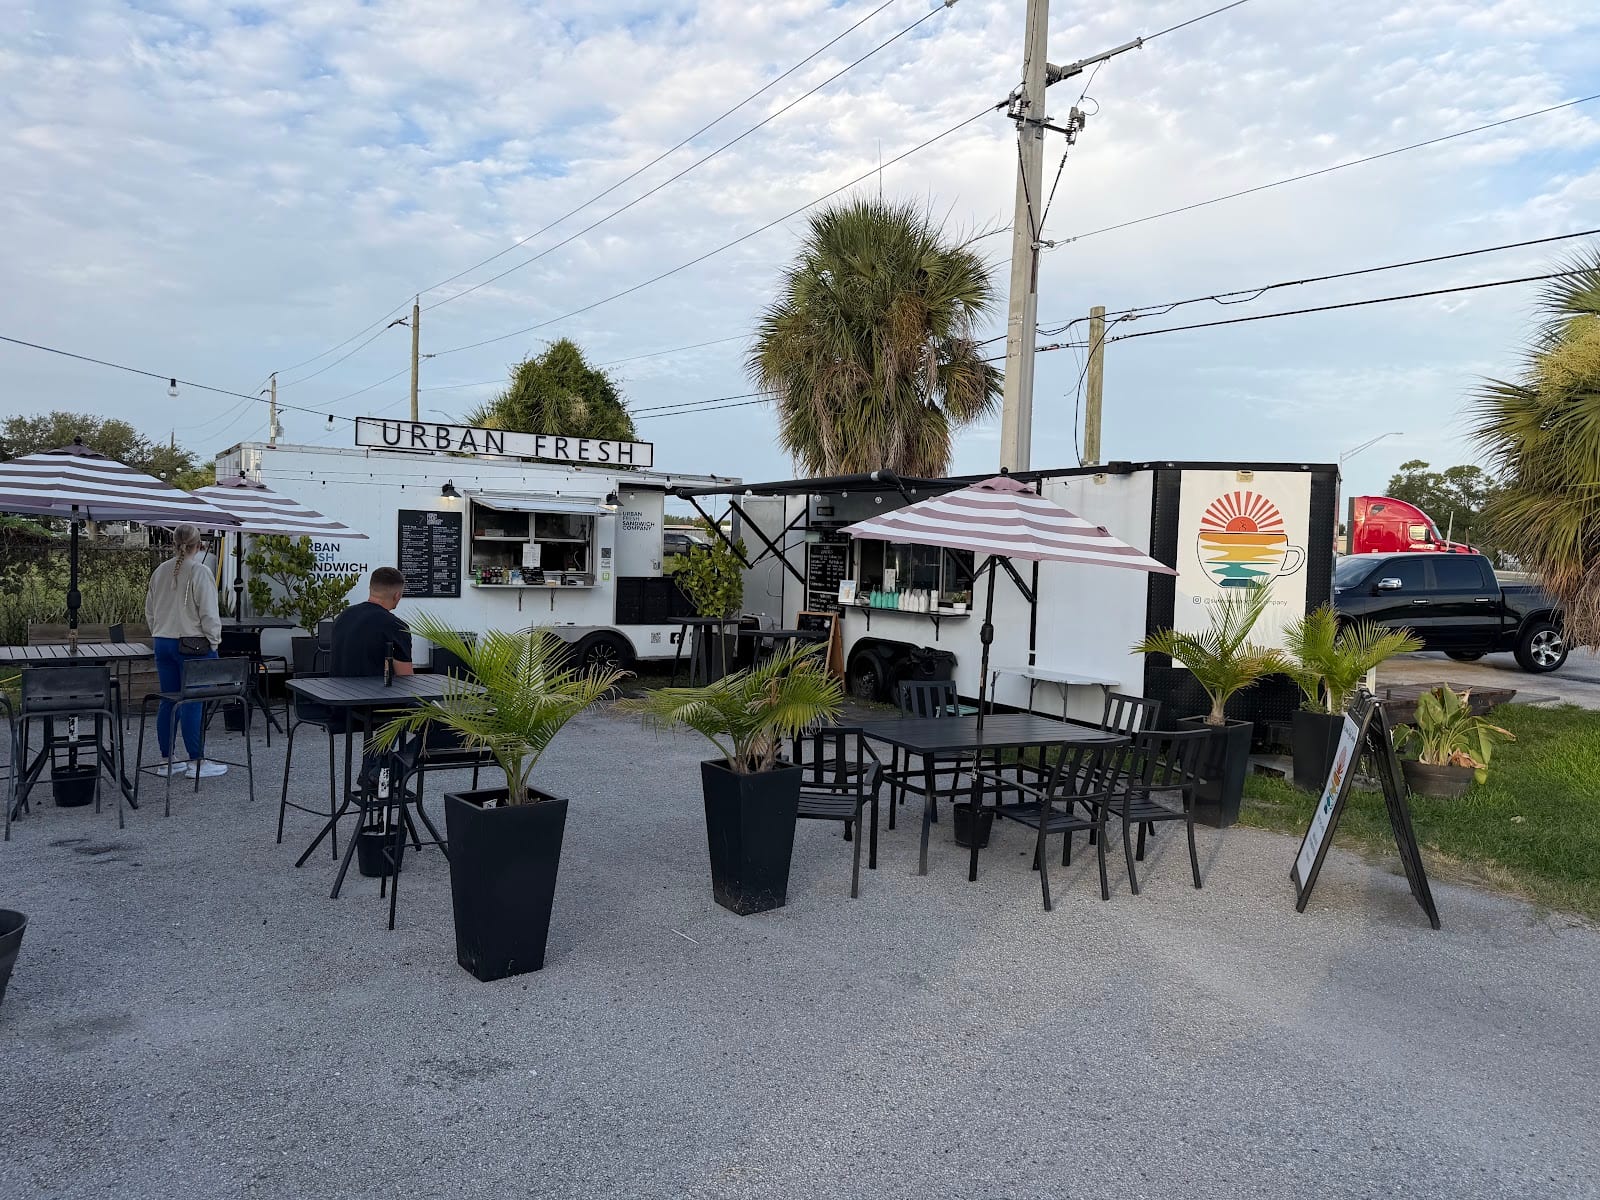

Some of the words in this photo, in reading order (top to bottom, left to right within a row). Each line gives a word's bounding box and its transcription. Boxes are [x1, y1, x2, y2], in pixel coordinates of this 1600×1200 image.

[382, 421, 504, 454] URBAN
[535, 435, 633, 464] FRESH
[296, 542, 341, 552] RBAN
[305, 562, 368, 572] ANDWICH
